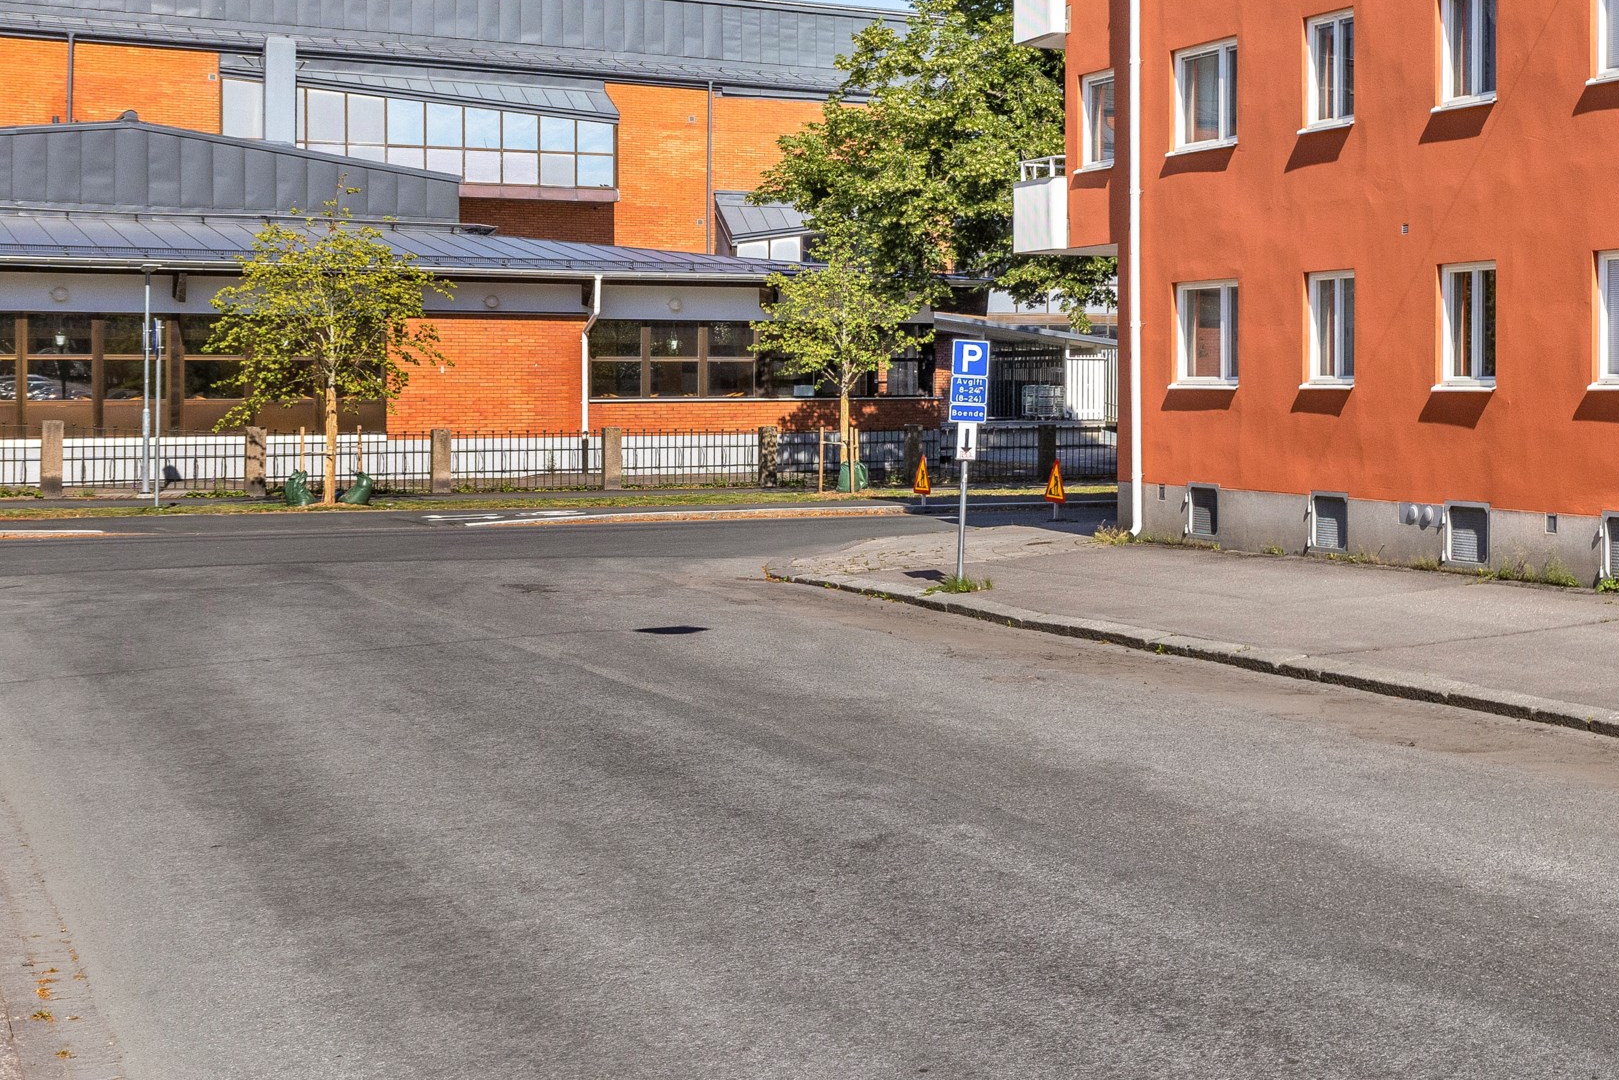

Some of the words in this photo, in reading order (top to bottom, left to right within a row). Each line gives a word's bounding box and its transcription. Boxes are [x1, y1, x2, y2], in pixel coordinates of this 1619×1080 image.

[961, 344, 983, 373] P
[956, 378, 983, 387] Avgift
[955, 394, 982, 403] (8-24)
[951, 409, 984, 417] Boende
